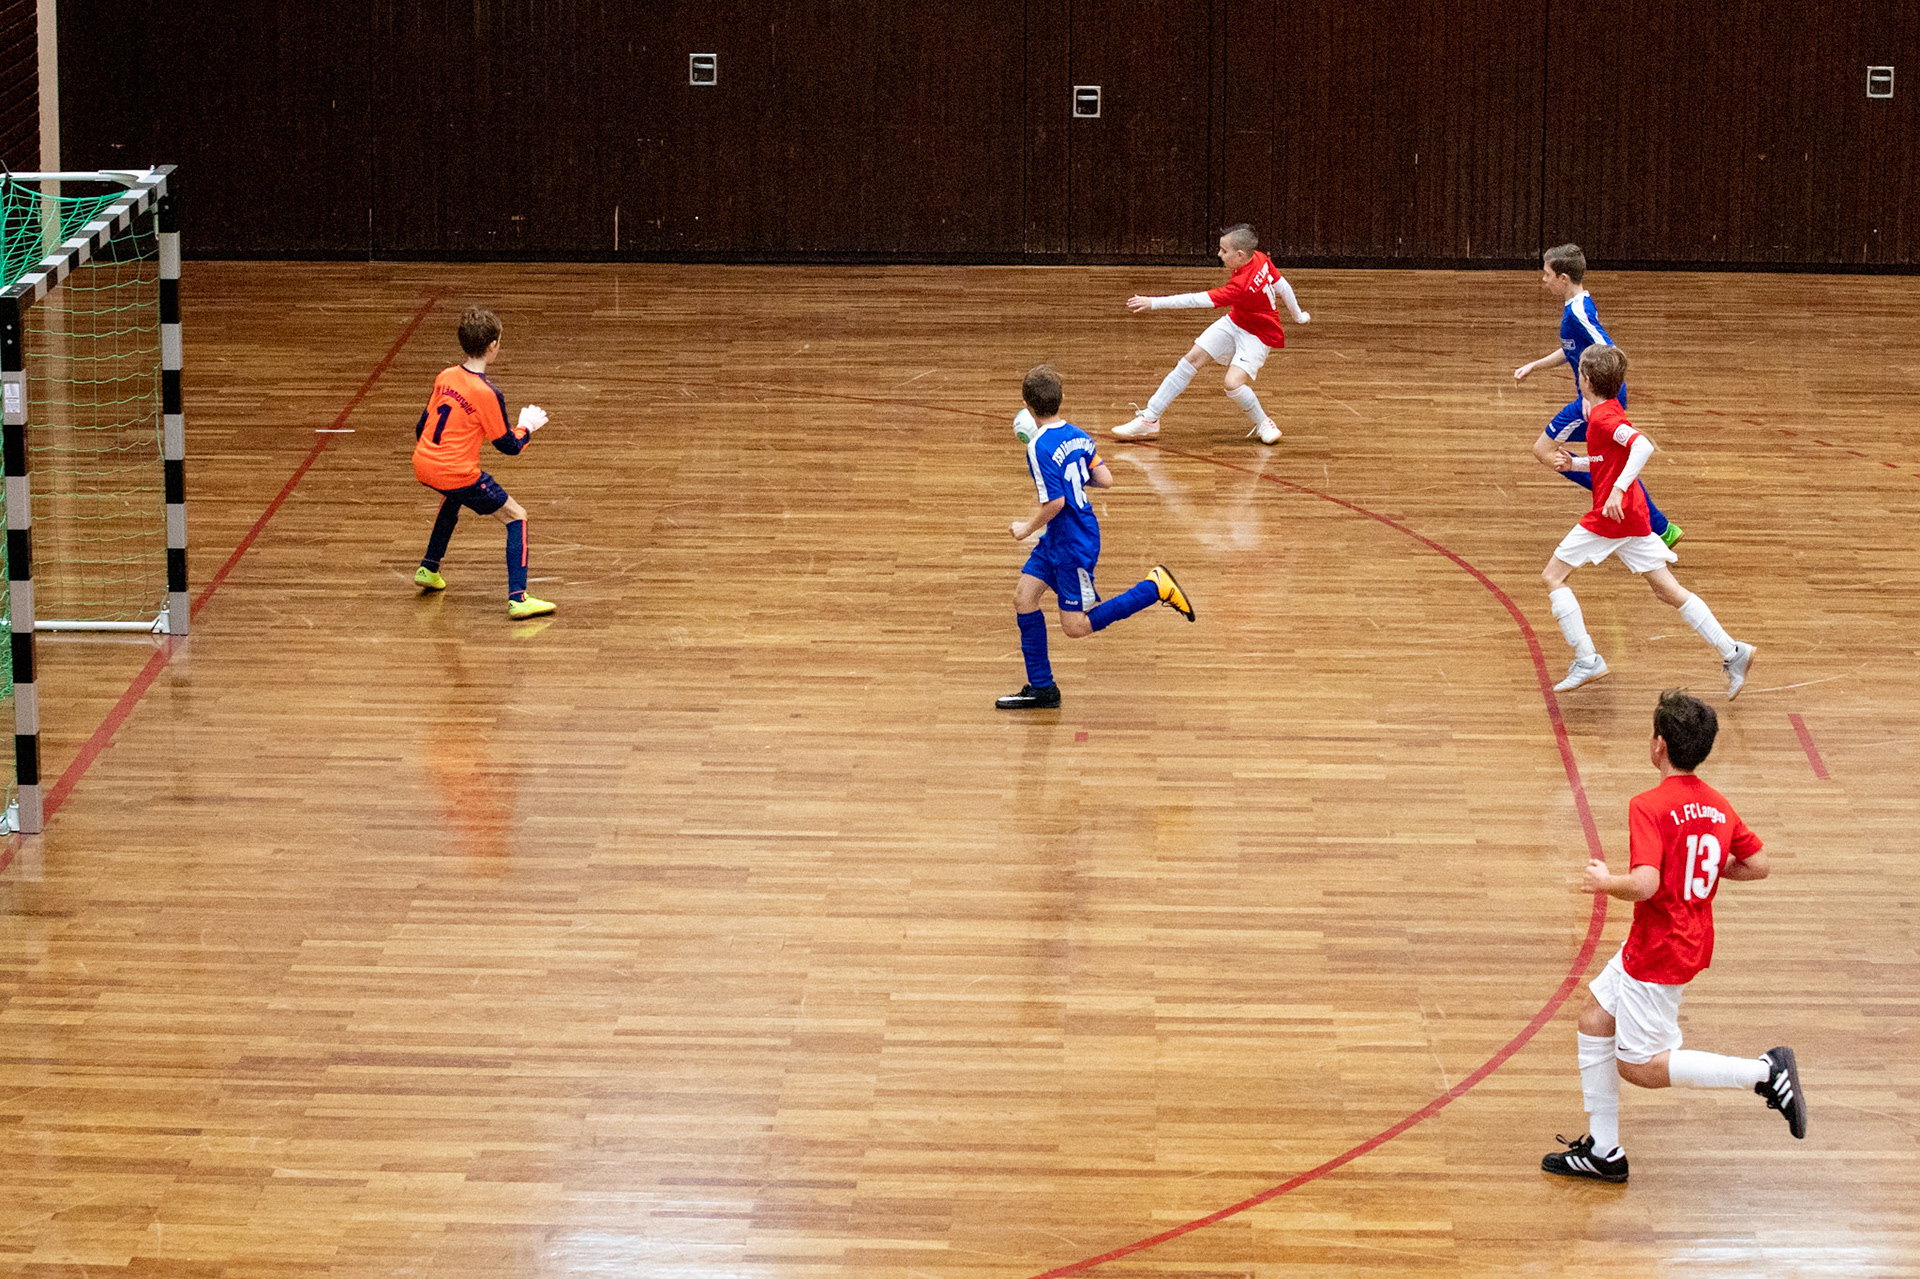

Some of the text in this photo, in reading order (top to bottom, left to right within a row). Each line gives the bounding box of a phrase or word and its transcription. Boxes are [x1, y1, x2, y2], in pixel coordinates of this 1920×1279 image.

[432, 403, 453, 445] 1
[1670, 809, 1685, 826] 1.
[1683, 803, 1697, 821] FC
[1684, 833, 1722, 901] 13
